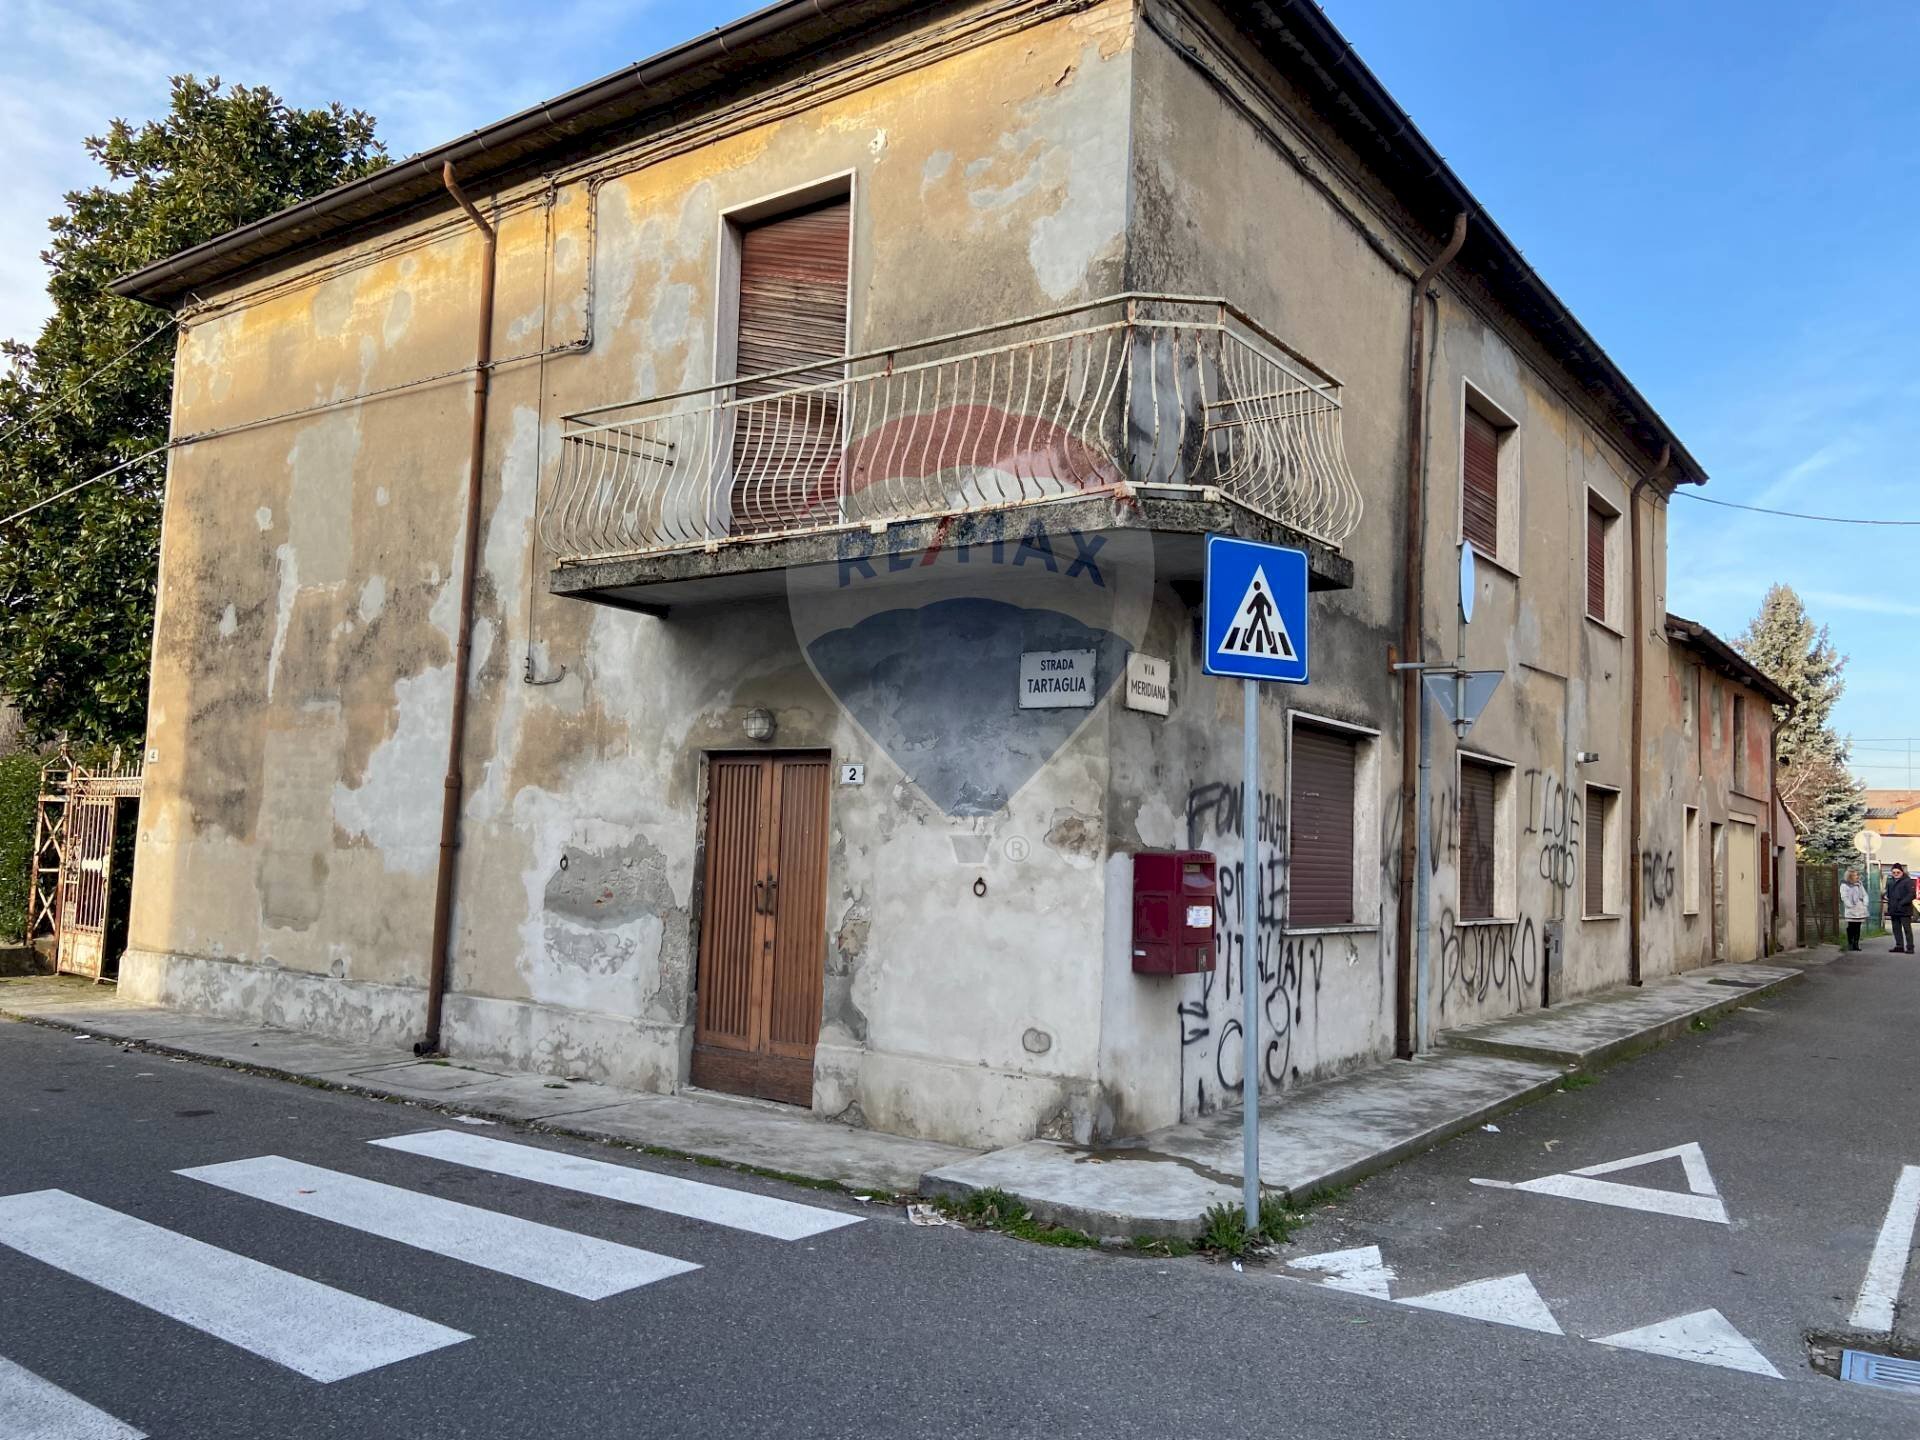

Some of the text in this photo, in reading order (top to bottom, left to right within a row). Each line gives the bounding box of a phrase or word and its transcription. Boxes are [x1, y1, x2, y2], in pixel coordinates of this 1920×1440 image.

[1040, 658, 1074, 671] STRADA
[1144, 663, 1155, 676] VIA
[1027, 677, 1087, 693] TARTAGLIA
[1130, 679, 1167, 701] MERIDIANA
[848, 767, 857, 781] 2
[1186, 780, 1288, 853] FONANA
